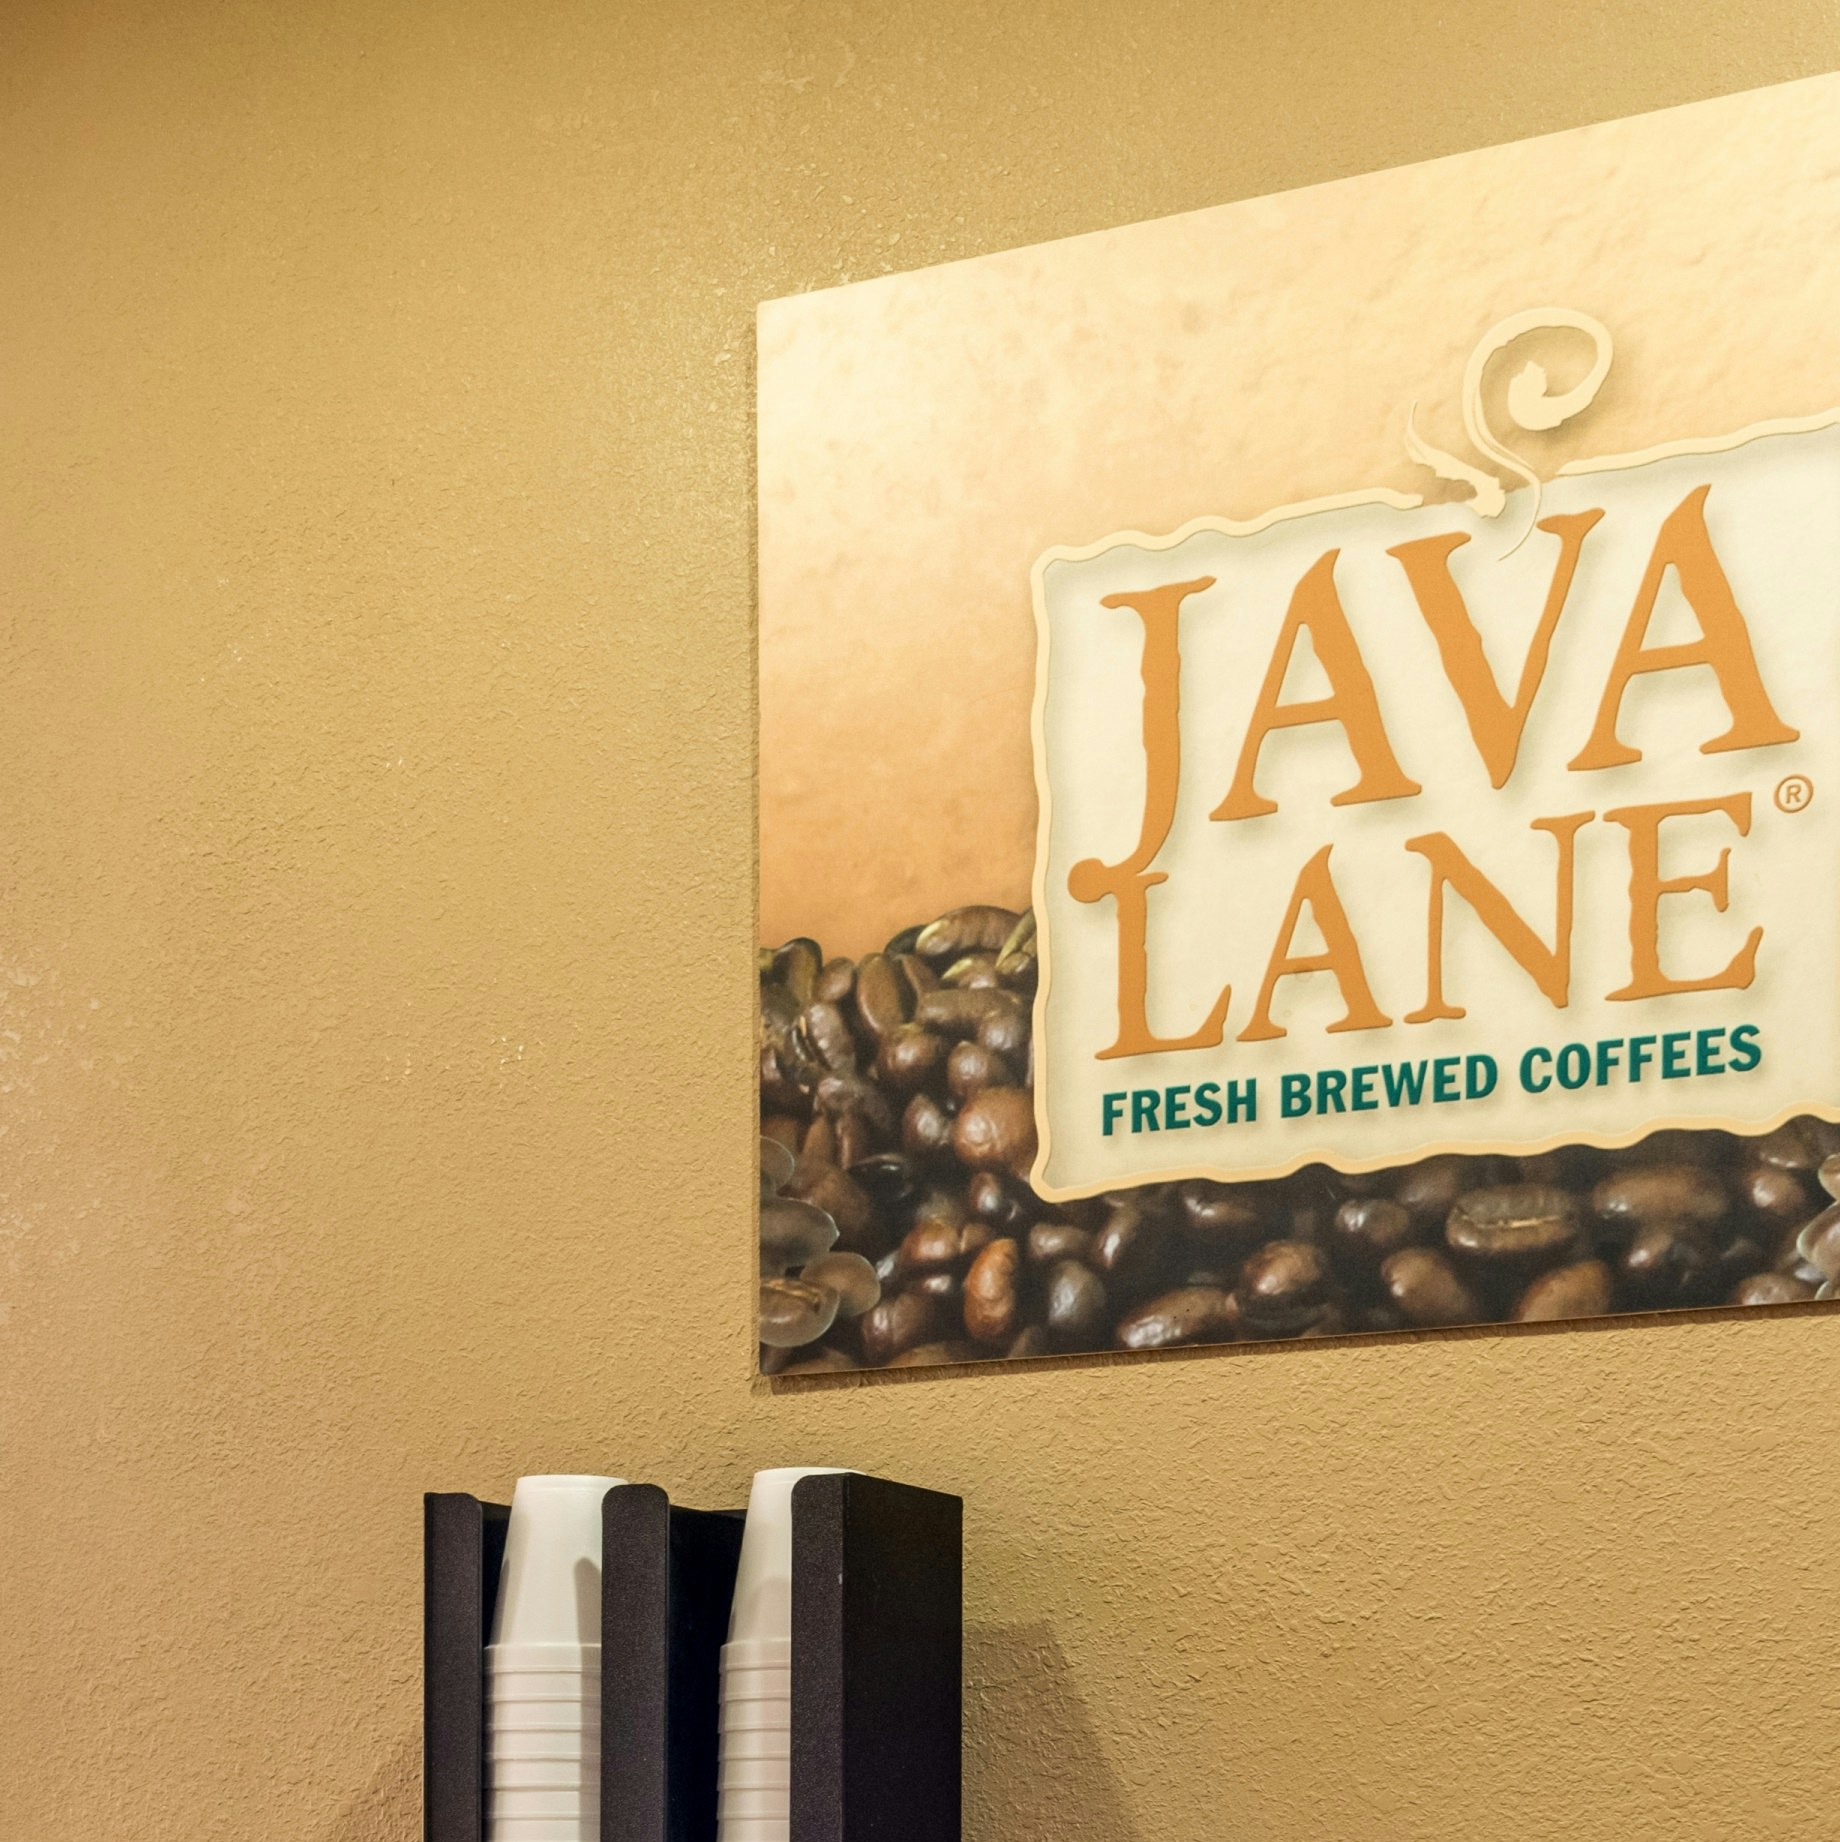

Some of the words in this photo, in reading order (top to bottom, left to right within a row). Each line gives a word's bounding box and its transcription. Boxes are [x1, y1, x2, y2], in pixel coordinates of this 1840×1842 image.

[1067, 485, 1800, 903] JAVA
[1095, 791, 1764, 1060] LANE
[1102, 1077, 1257, 1136] FRESH
[1280, 1053, 1499, 1119] BREWED
[1520, 1024, 1763, 1093] COFFEES
